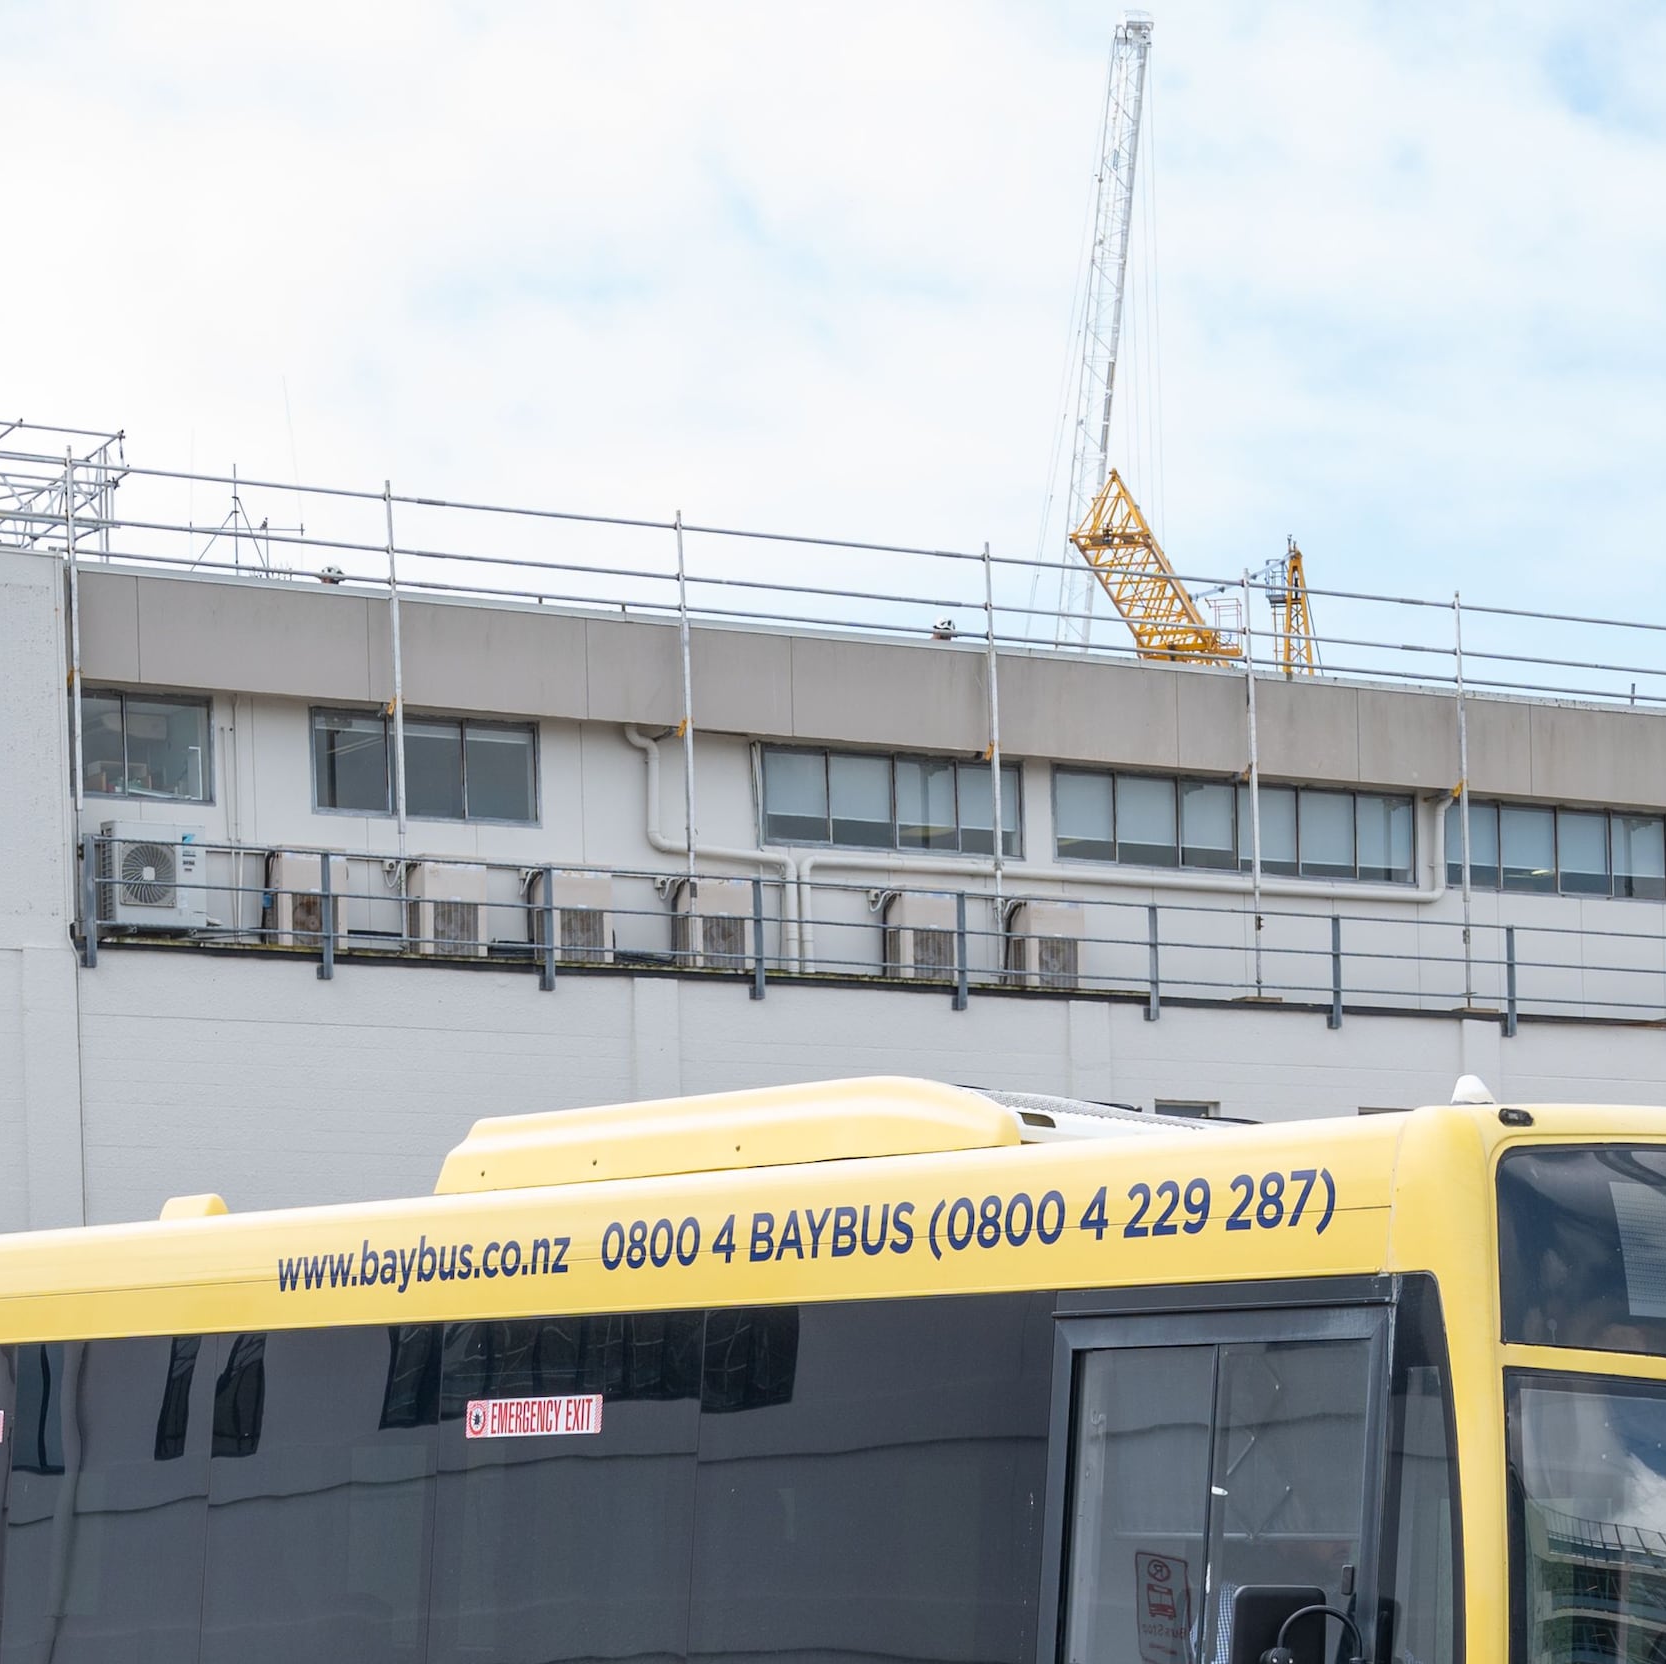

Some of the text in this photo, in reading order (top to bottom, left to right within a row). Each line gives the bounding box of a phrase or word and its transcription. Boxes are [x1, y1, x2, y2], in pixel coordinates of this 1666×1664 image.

[278, 1167, 1336, 1294] www.baybus.co.nz 0800 4 BAYBUS (0800 4 229 287)
[490, 1398, 593, 1434] EMERGENCY EXIT
